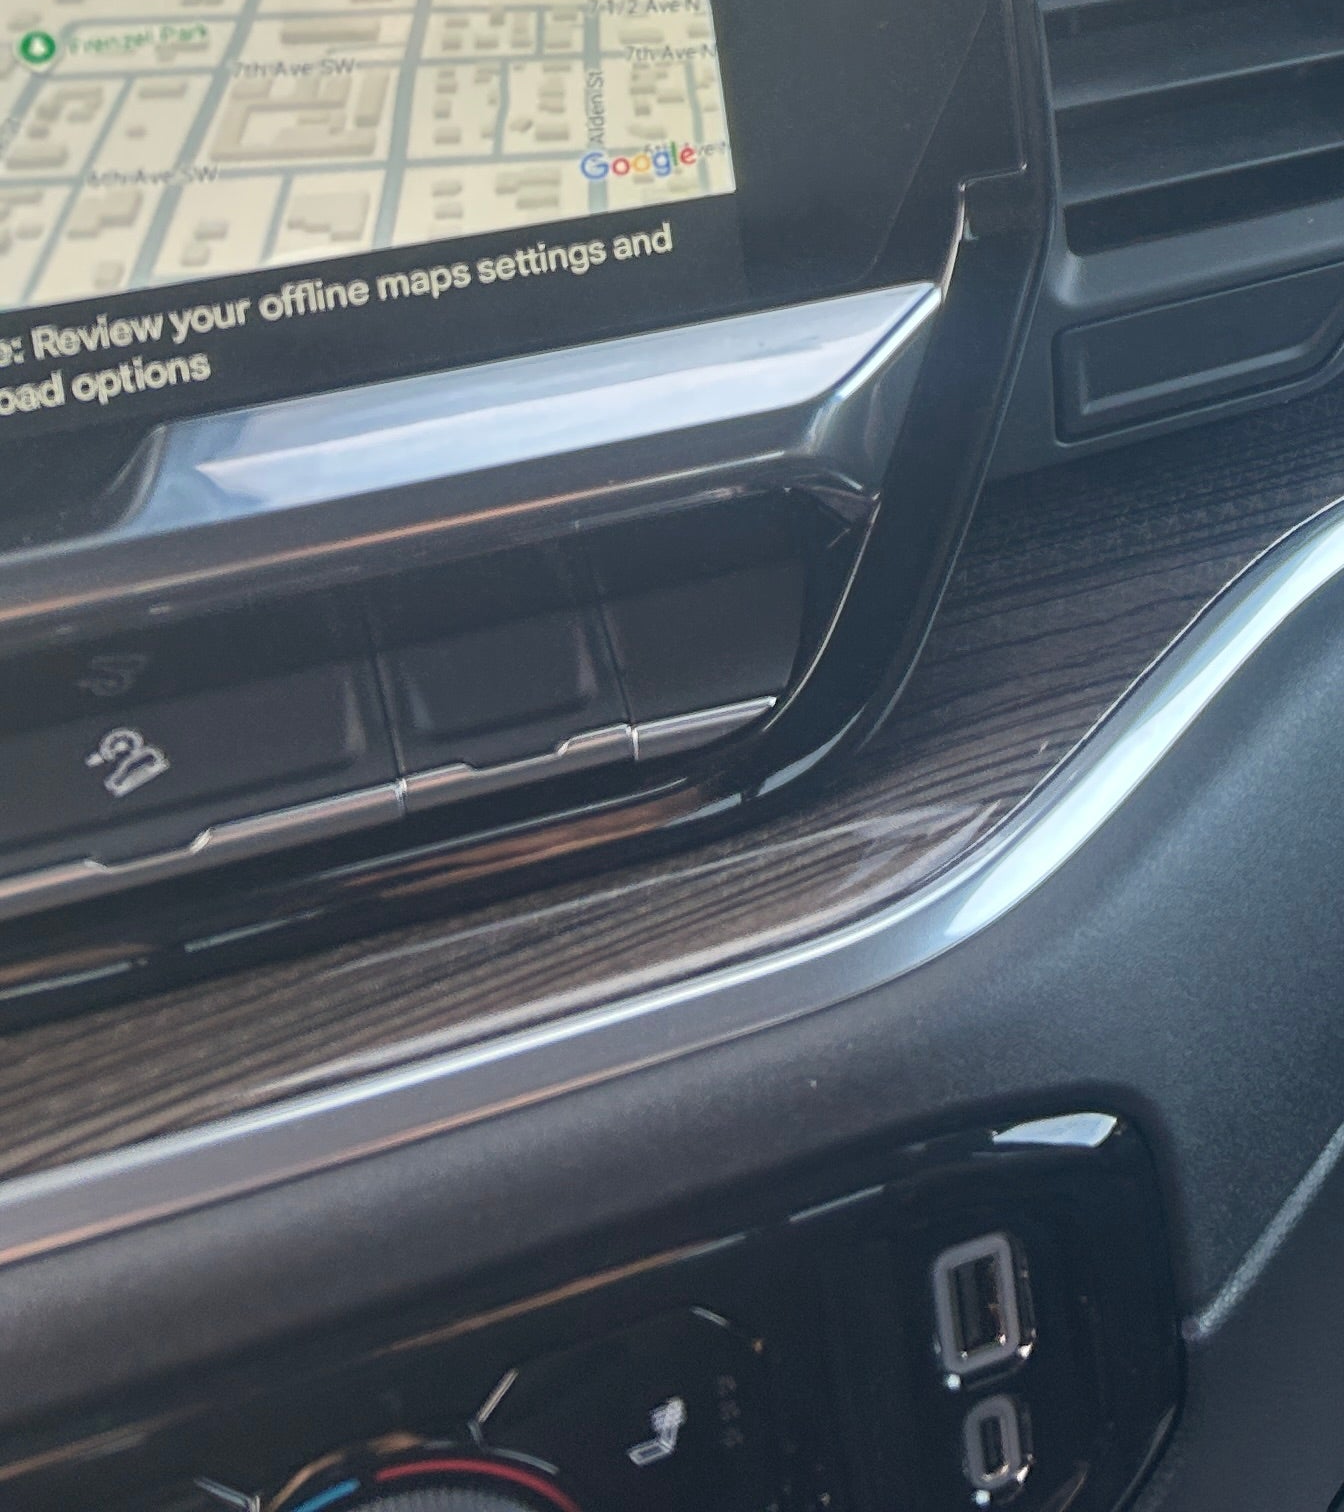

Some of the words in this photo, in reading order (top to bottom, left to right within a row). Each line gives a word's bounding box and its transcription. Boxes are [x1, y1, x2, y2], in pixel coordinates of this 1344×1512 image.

[275, 60, 313, 78] Ave
[320, 57, 356, 75] SW
[662, 45, 696, 60] Ave
[180, 165, 219, 183] SW
[580, 141, 697, 181] Google
[31, 314, 164, 361] Review
[167, 298, 250, 344] your
[258, 278, 368, 321] offline
[376, 262, 471, 299] maps
[477, 241, 606, 283] settings
[612, 221, 673, 260] and
[72, 352, 211, 405] options
